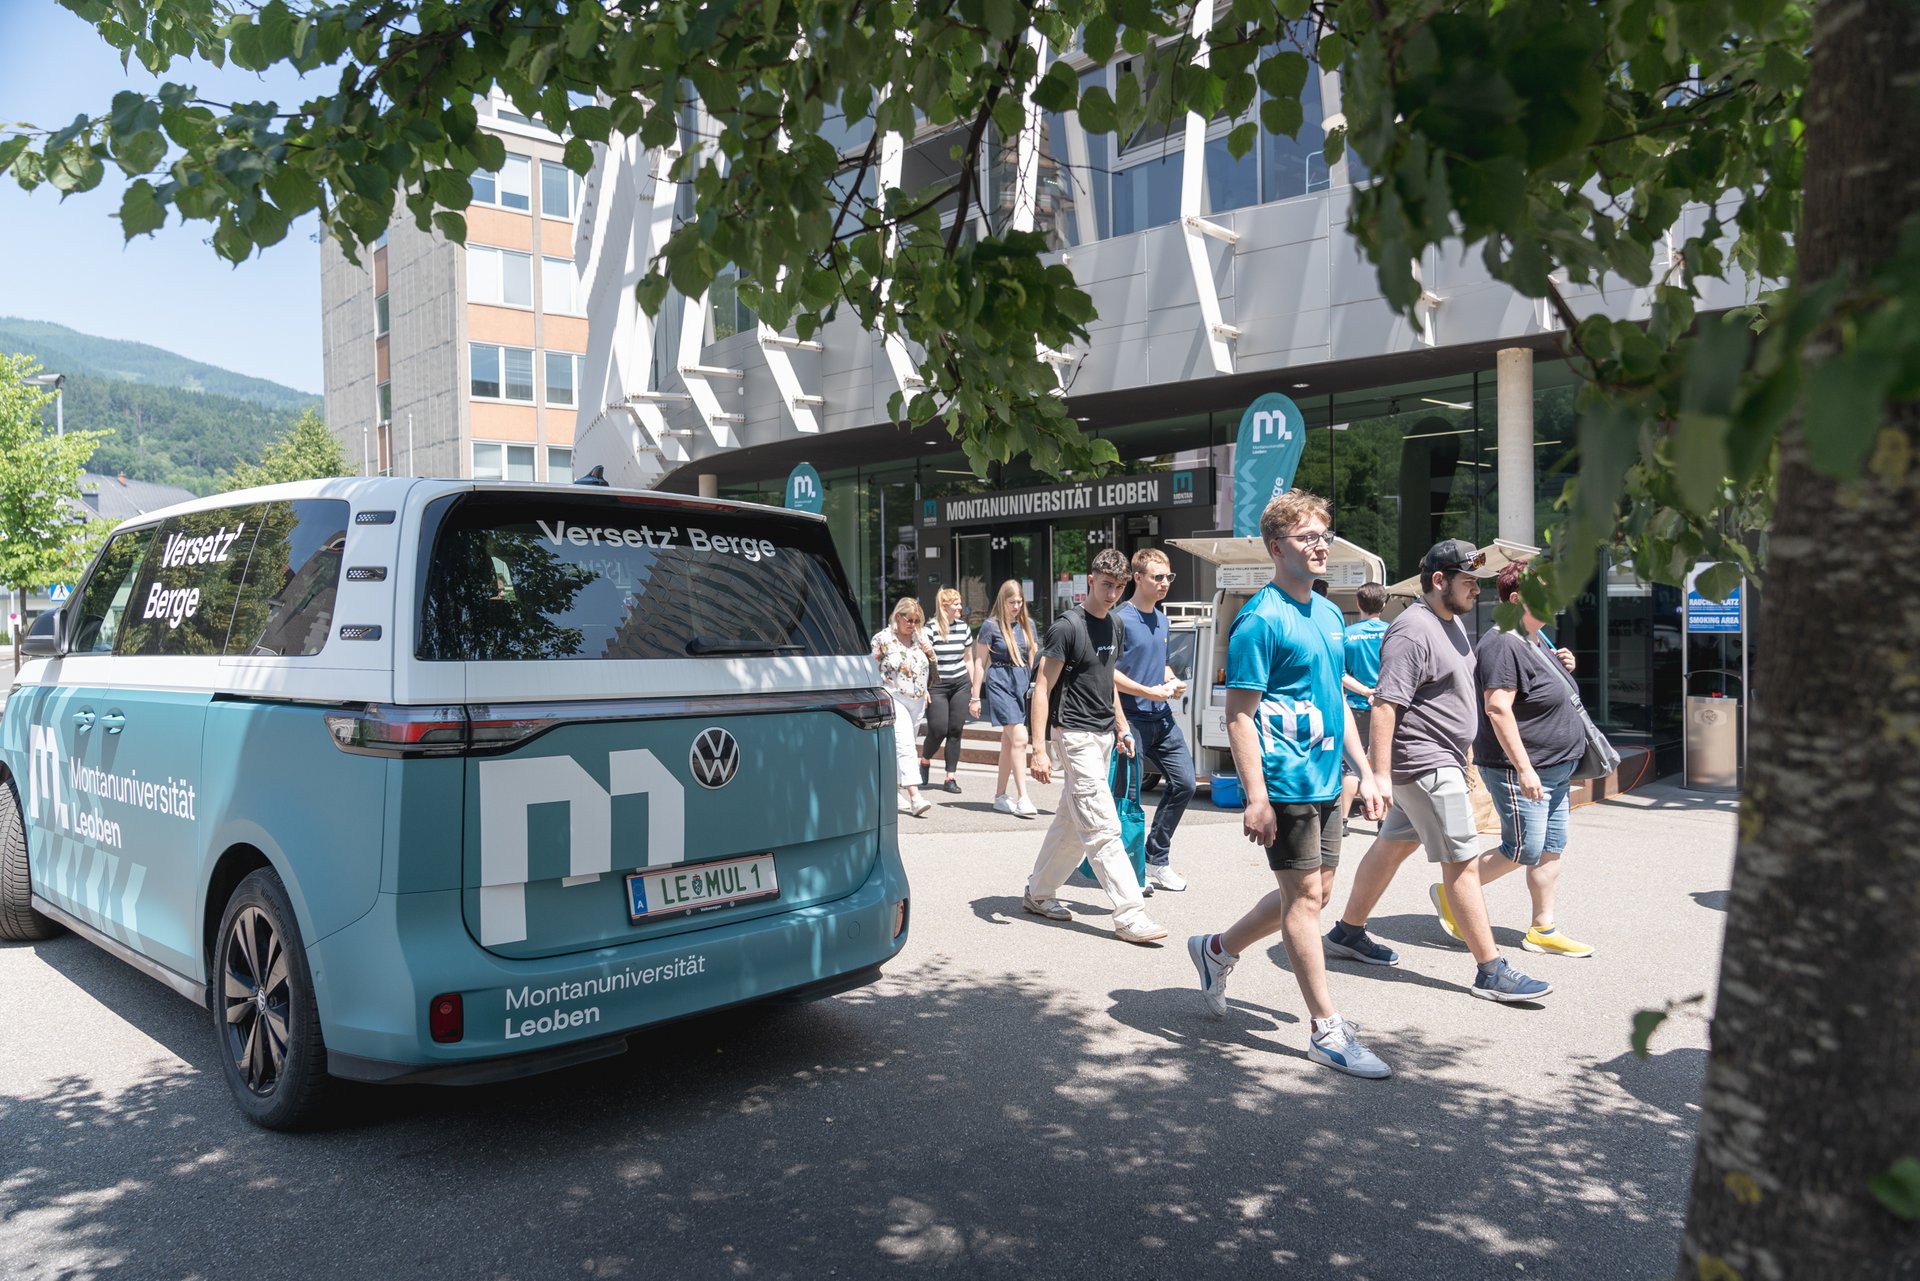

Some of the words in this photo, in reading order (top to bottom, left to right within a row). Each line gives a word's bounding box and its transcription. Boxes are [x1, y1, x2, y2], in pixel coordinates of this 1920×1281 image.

[946, 483, 1093, 521] MONTANUNIVERSITÄT
[1098, 480, 1159, 507] LEOBEN
[686, 527, 777, 562] Berge
[143, 582, 200, 629] Berge
[1689, 616, 1720, 624] SMOKING
[1721, 616, 1739, 624] AREA
[70, 756, 196, 821] Montanuniversität
[72, 802, 122, 849] Leoben
[637, 900, 645, 909] A
[661, 875, 690, 905] LE
[705, 866, 747, 897] MUL
[750, 863, 761, 889] 1
[505, 954, 706, 1010] Montanuniversität
[505, 1006, 600, 1040] Leoben
